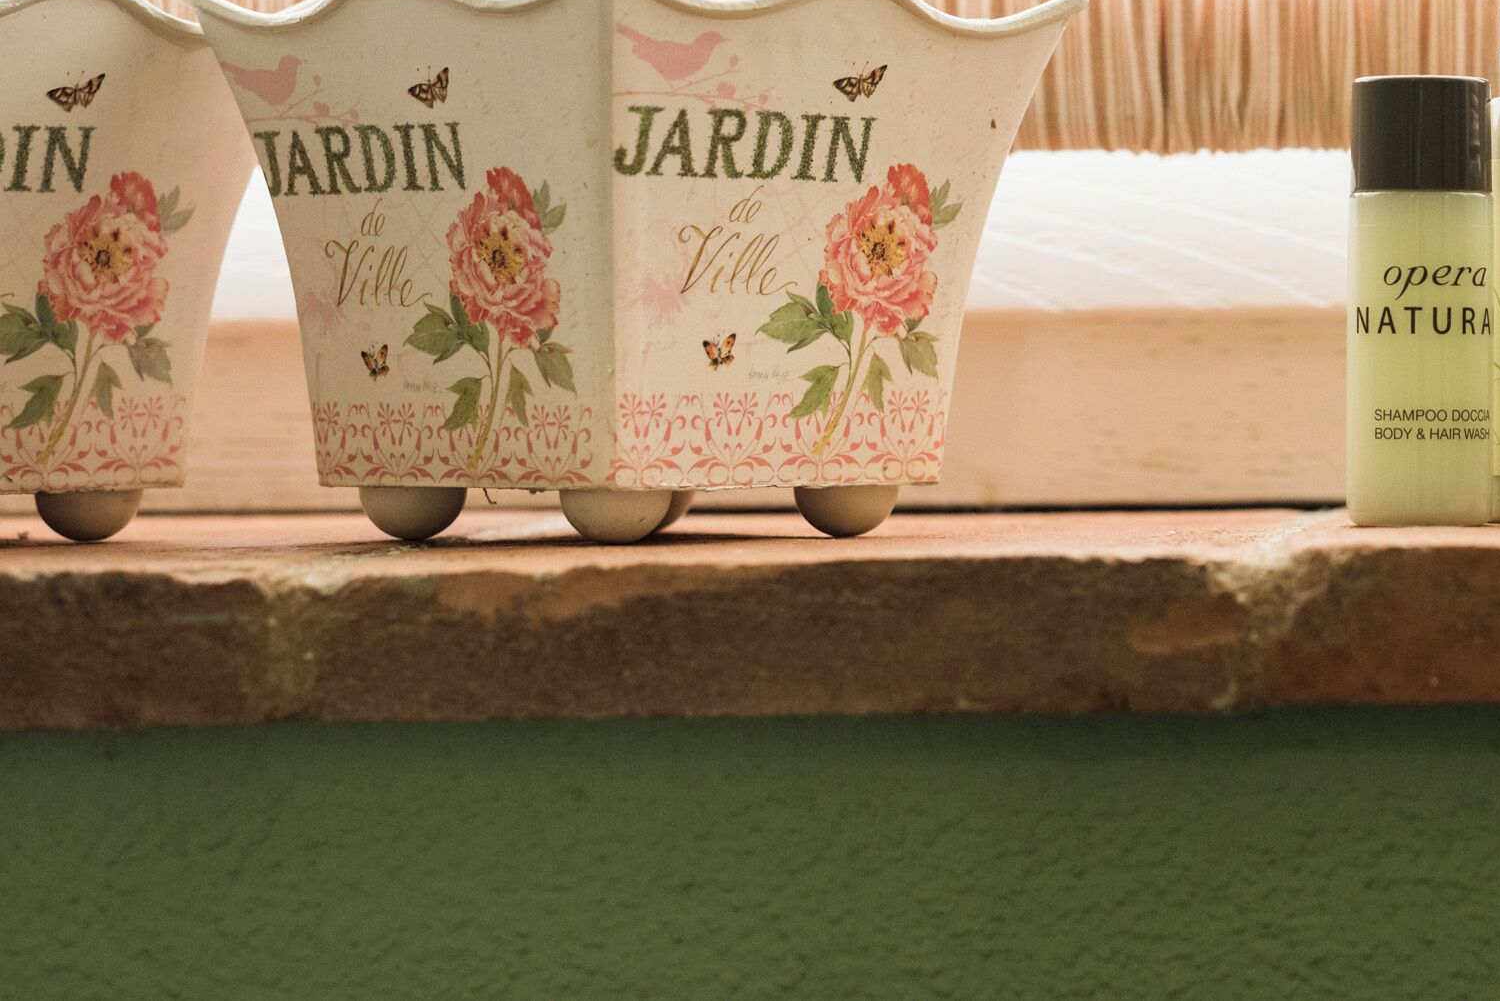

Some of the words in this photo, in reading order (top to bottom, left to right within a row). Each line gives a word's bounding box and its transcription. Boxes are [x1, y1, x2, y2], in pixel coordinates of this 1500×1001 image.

[0, 123, 97, 193] IN
[253, 121, 466, 197] JARDIN
[613, 105, 877, 183] JARDIN
[360, 197, 386, 237] de
[729, 185, 764, 224] de
[324, 239, 433, 307] Ville
[678, 224, 798, 296] Ville
[1383, 263, 1488, 302] opera
[1374, 408, 1448, 422] SHAMPOO
[1451, 409, 1490, 422] DOCCIA
[1374, 427, 1412, 440] BODY
[1416, 428, 1426, 440] &
[1429, 428, 1461, 440] HAIR
[1463, 428, 1490, 440] WASH
